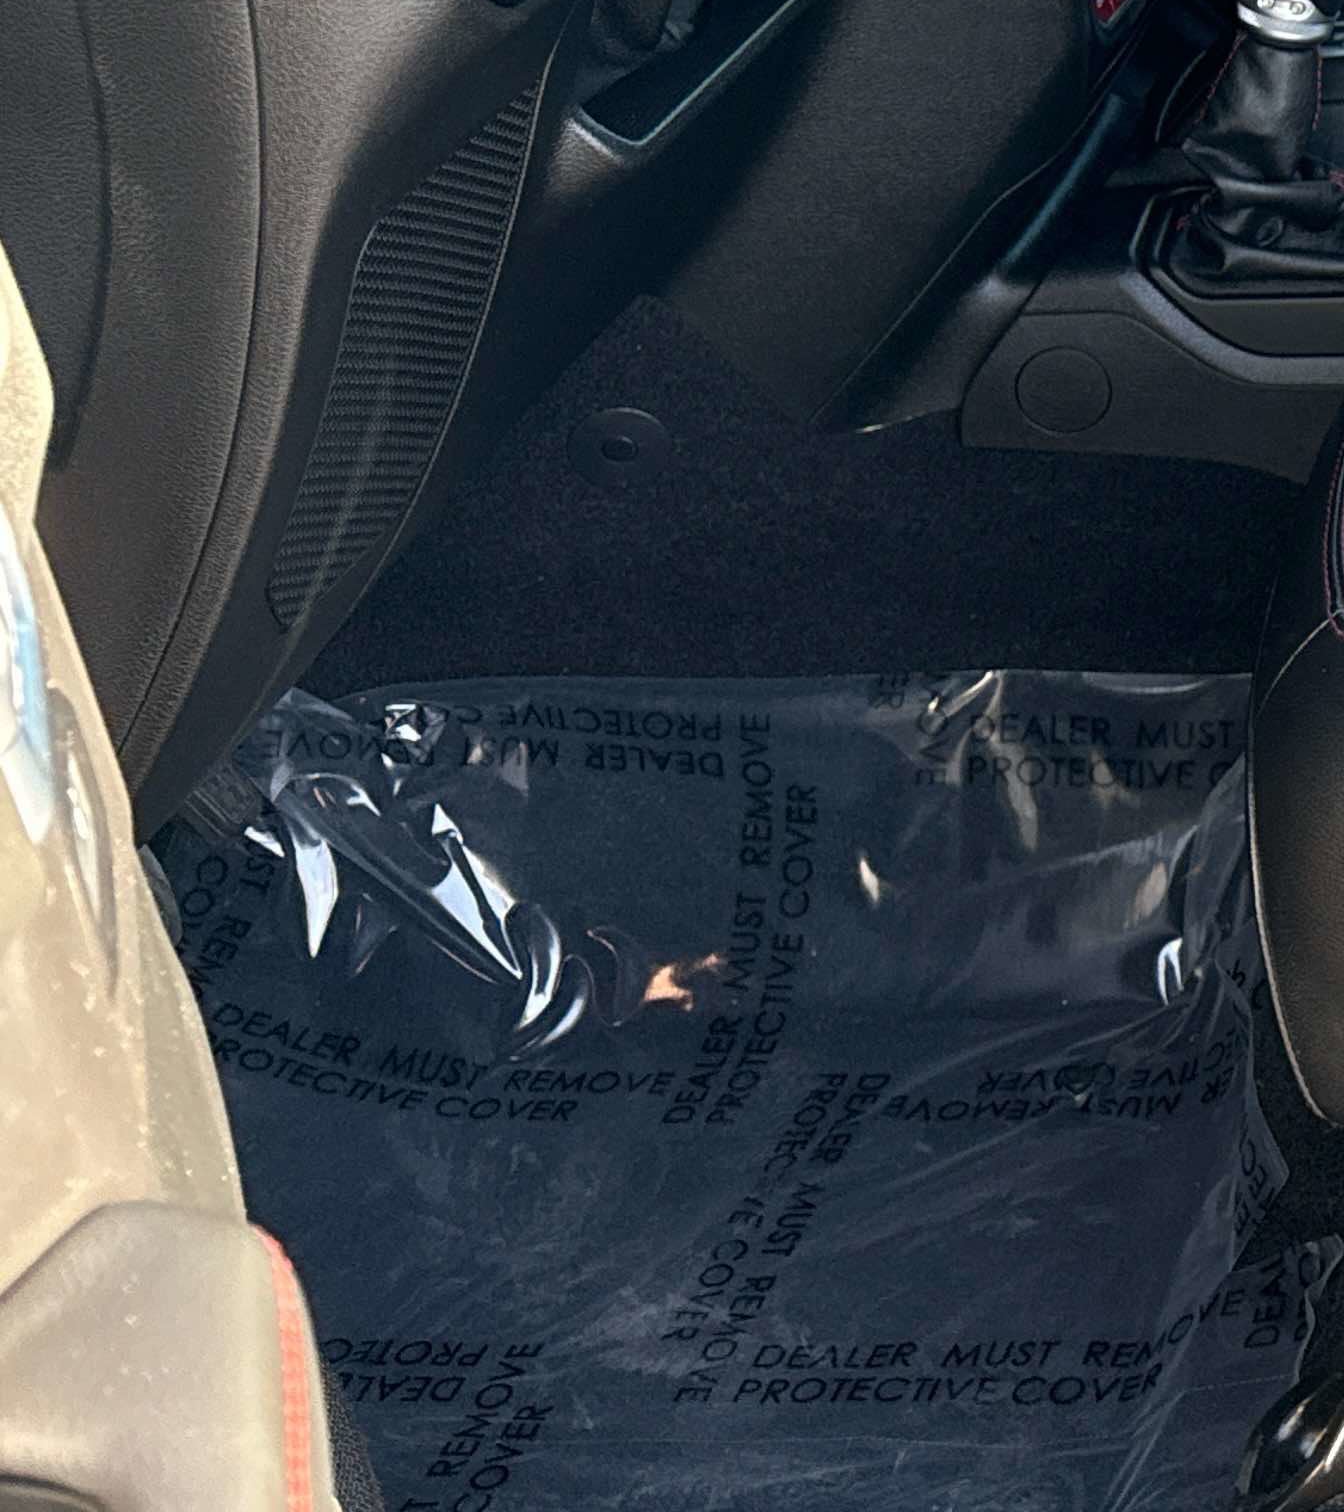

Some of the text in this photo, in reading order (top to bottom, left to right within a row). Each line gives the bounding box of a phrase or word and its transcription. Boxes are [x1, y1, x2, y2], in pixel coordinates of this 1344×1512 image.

[500, 704, 721, 741] PROTECTIVE
[970, 714, 1236, 750] DEALER MUST
[585, 742, 724, 778] DEALER
[967, 756, 1196, 790] PROTECTIVE
[662, 713, 774, 1124] DEALER MUST REMOVE
[705, 785, 818, 1125] PROTECTIVE COVER
[213, 1002, 676, 1096] DEALER MUST REMOVE
[436, 1095, 578, 1121] COVER
[808, 1072, 892, 1164] DEALER
[761, 1182, 820, 1258] MUST
[663, 1237, 749, 1341] COVER
[319, 1337, 489, 1367] PROTEC
[752, 1342, 918, 1369] DEALER
[940, 1340, 1060, 1369] MUST
[427, 1342, 546, 1479] REMOVE
[732, 1362, 1162, 1405] PROTECTIVE COVER
[453, 1405, 555, 1512] COVER
